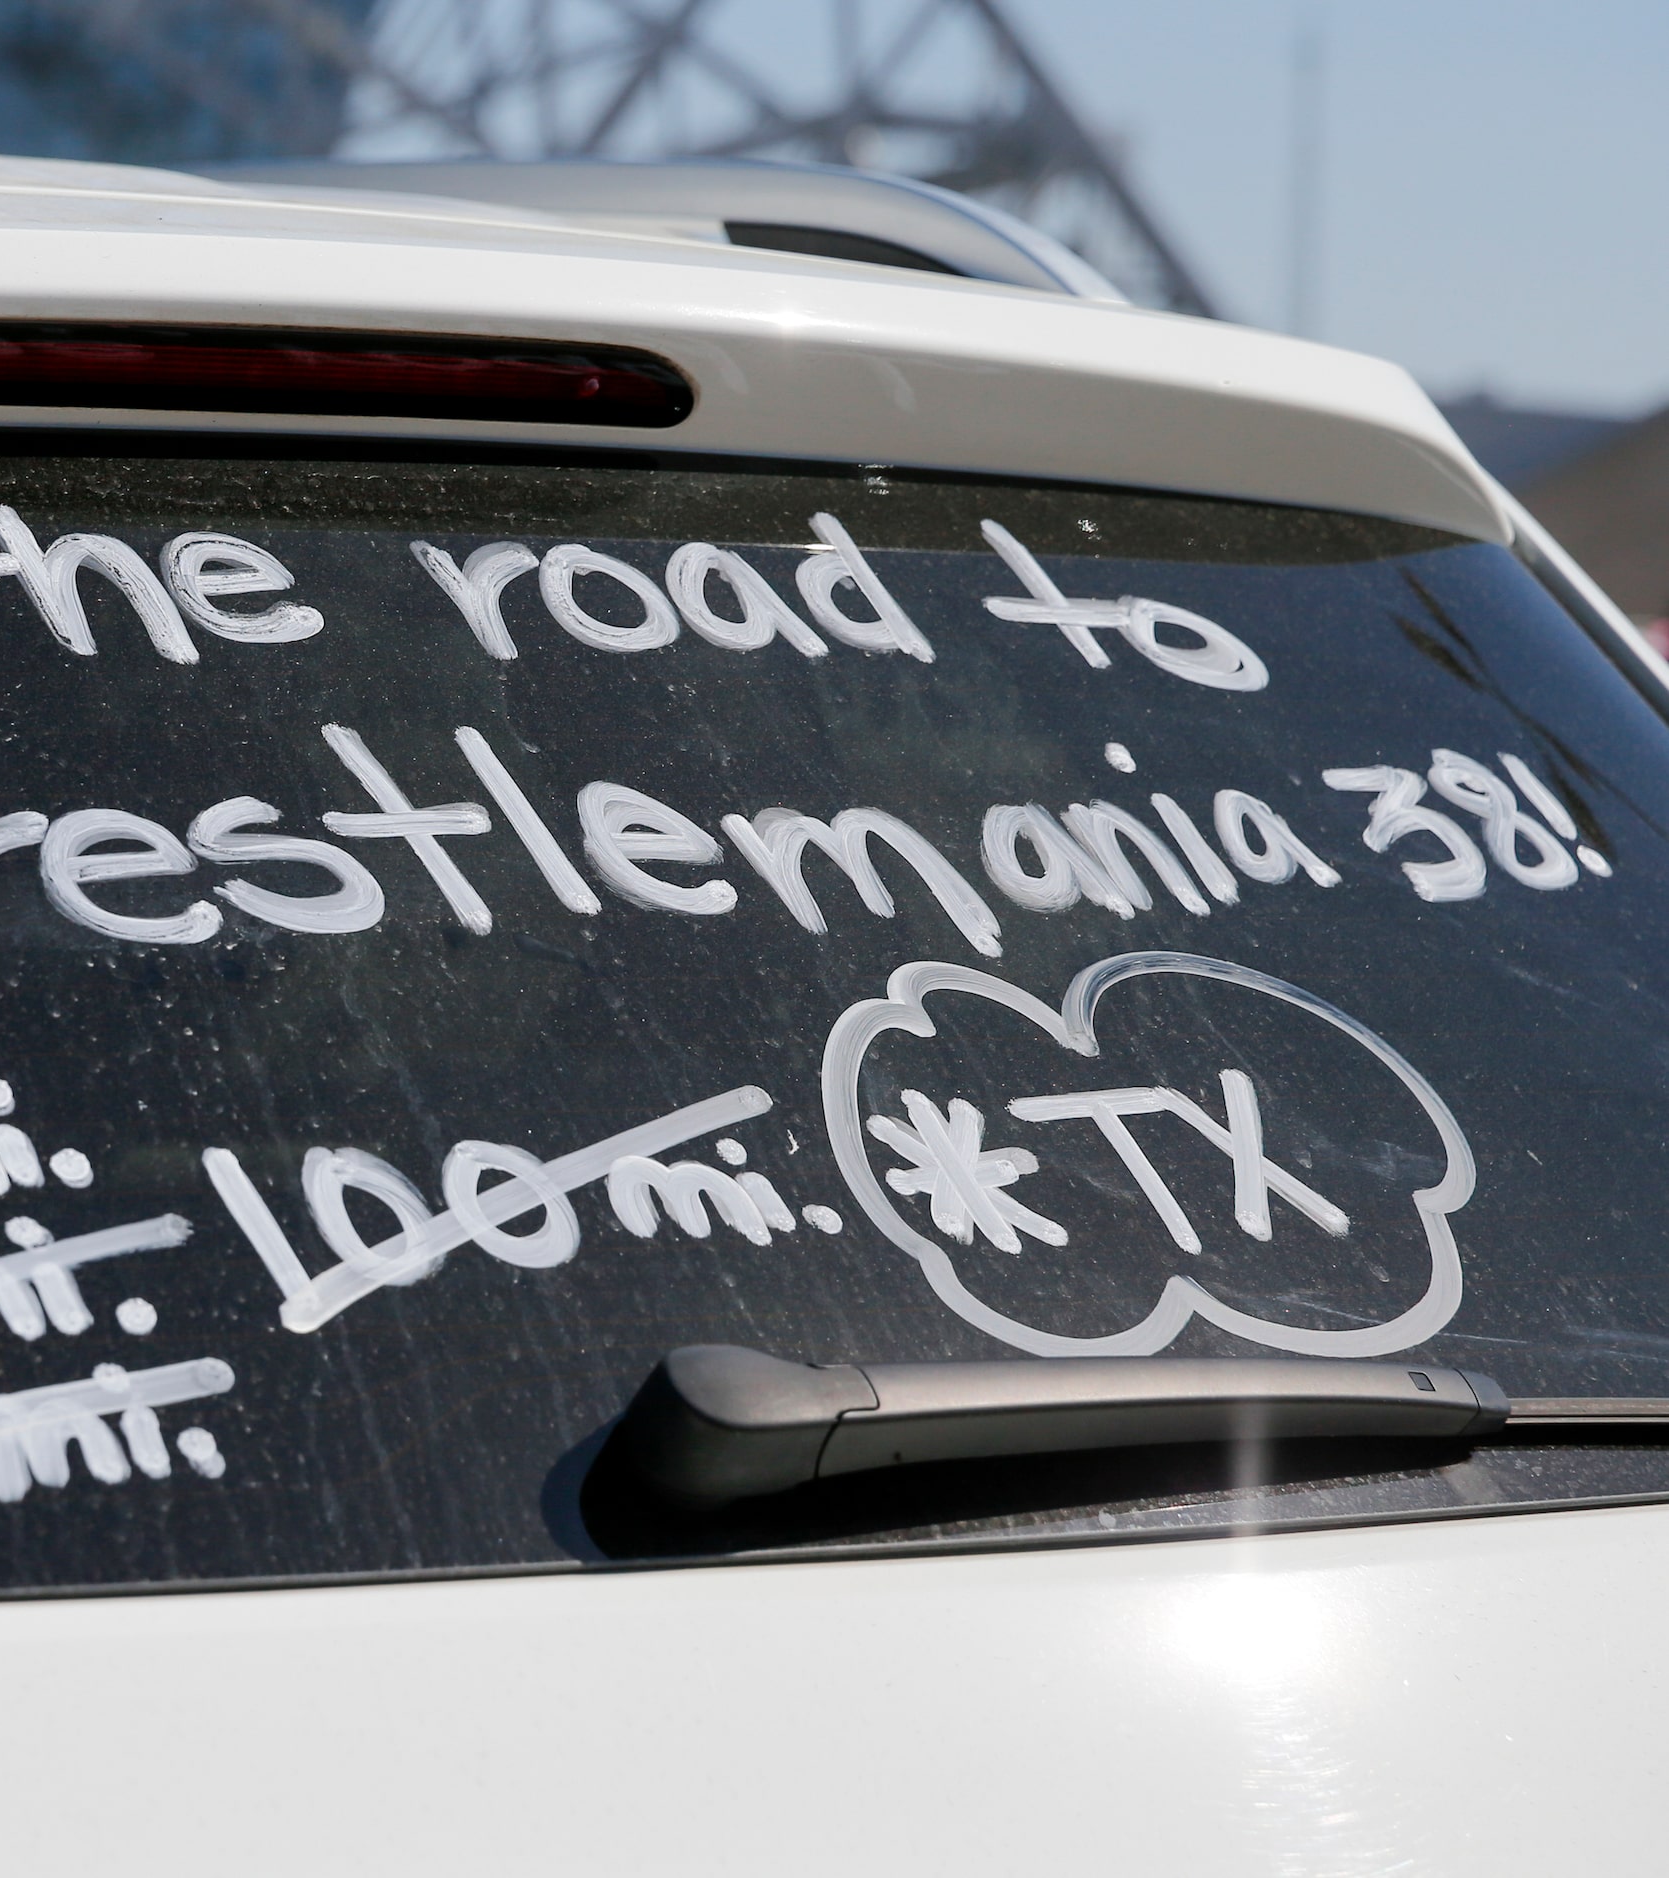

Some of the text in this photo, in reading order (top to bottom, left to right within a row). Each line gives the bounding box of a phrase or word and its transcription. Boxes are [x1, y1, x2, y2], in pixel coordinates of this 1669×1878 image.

[412, 511, 936, 663] road
[981, 517, 1270, 692] to
[1321, 747, 1614, 902] 38!
[1007, 1068, 1350, 1255] TX
